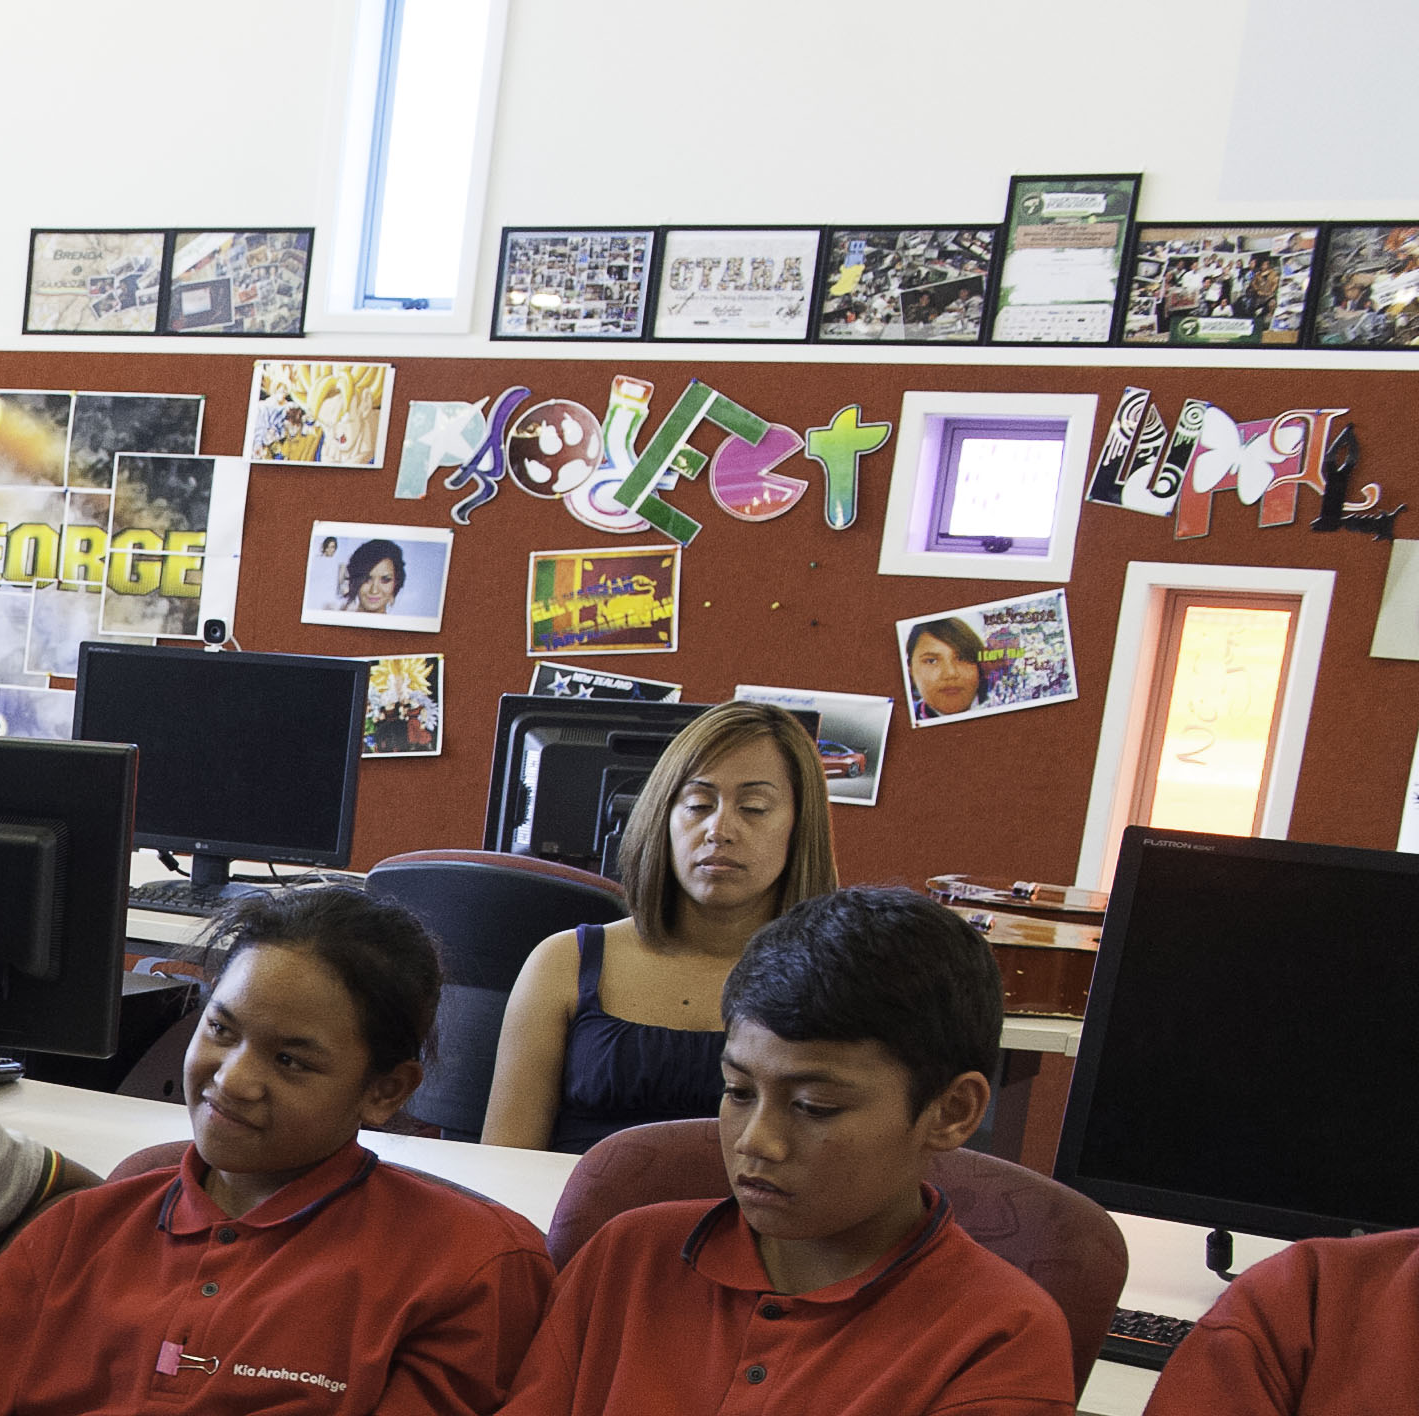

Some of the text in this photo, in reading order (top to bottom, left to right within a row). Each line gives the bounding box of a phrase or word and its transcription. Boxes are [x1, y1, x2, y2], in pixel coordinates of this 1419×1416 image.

[53, 249, 104, 261] BRENDA
[669, 256, 805, 292] OTARA
[571, 671, 594, 684] NEW
[1142, 838, 1191, 849] FLATRON
[233, 1363, 347, 1393] Kia Aroha College
